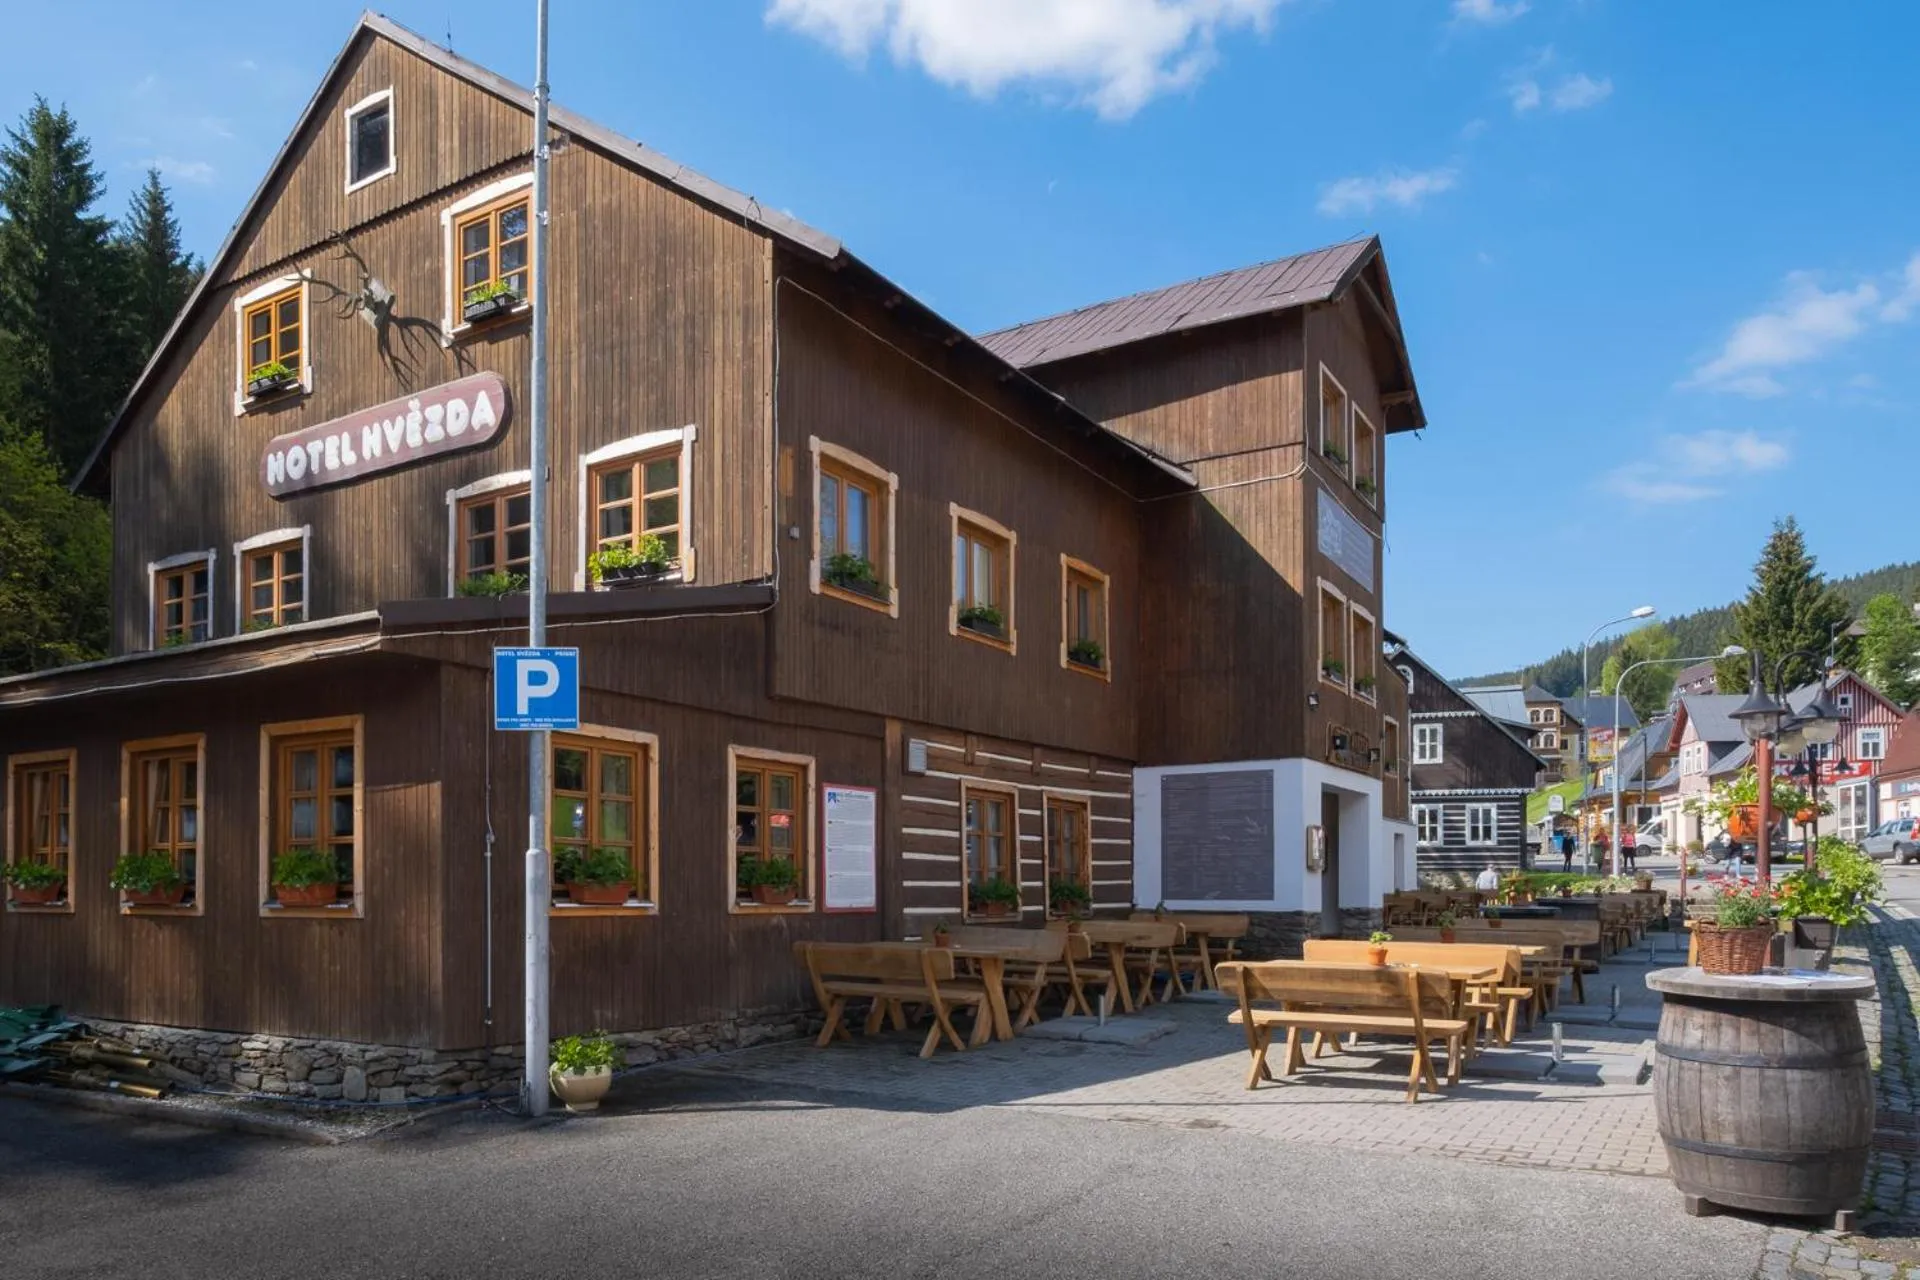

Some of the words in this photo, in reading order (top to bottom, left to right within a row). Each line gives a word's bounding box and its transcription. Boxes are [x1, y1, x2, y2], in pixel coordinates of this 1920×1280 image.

[267, 431, 357, 486] HOTEL
[362, 390, 496, 460] HVĚZDA
[516, 658, 560, 715] P
